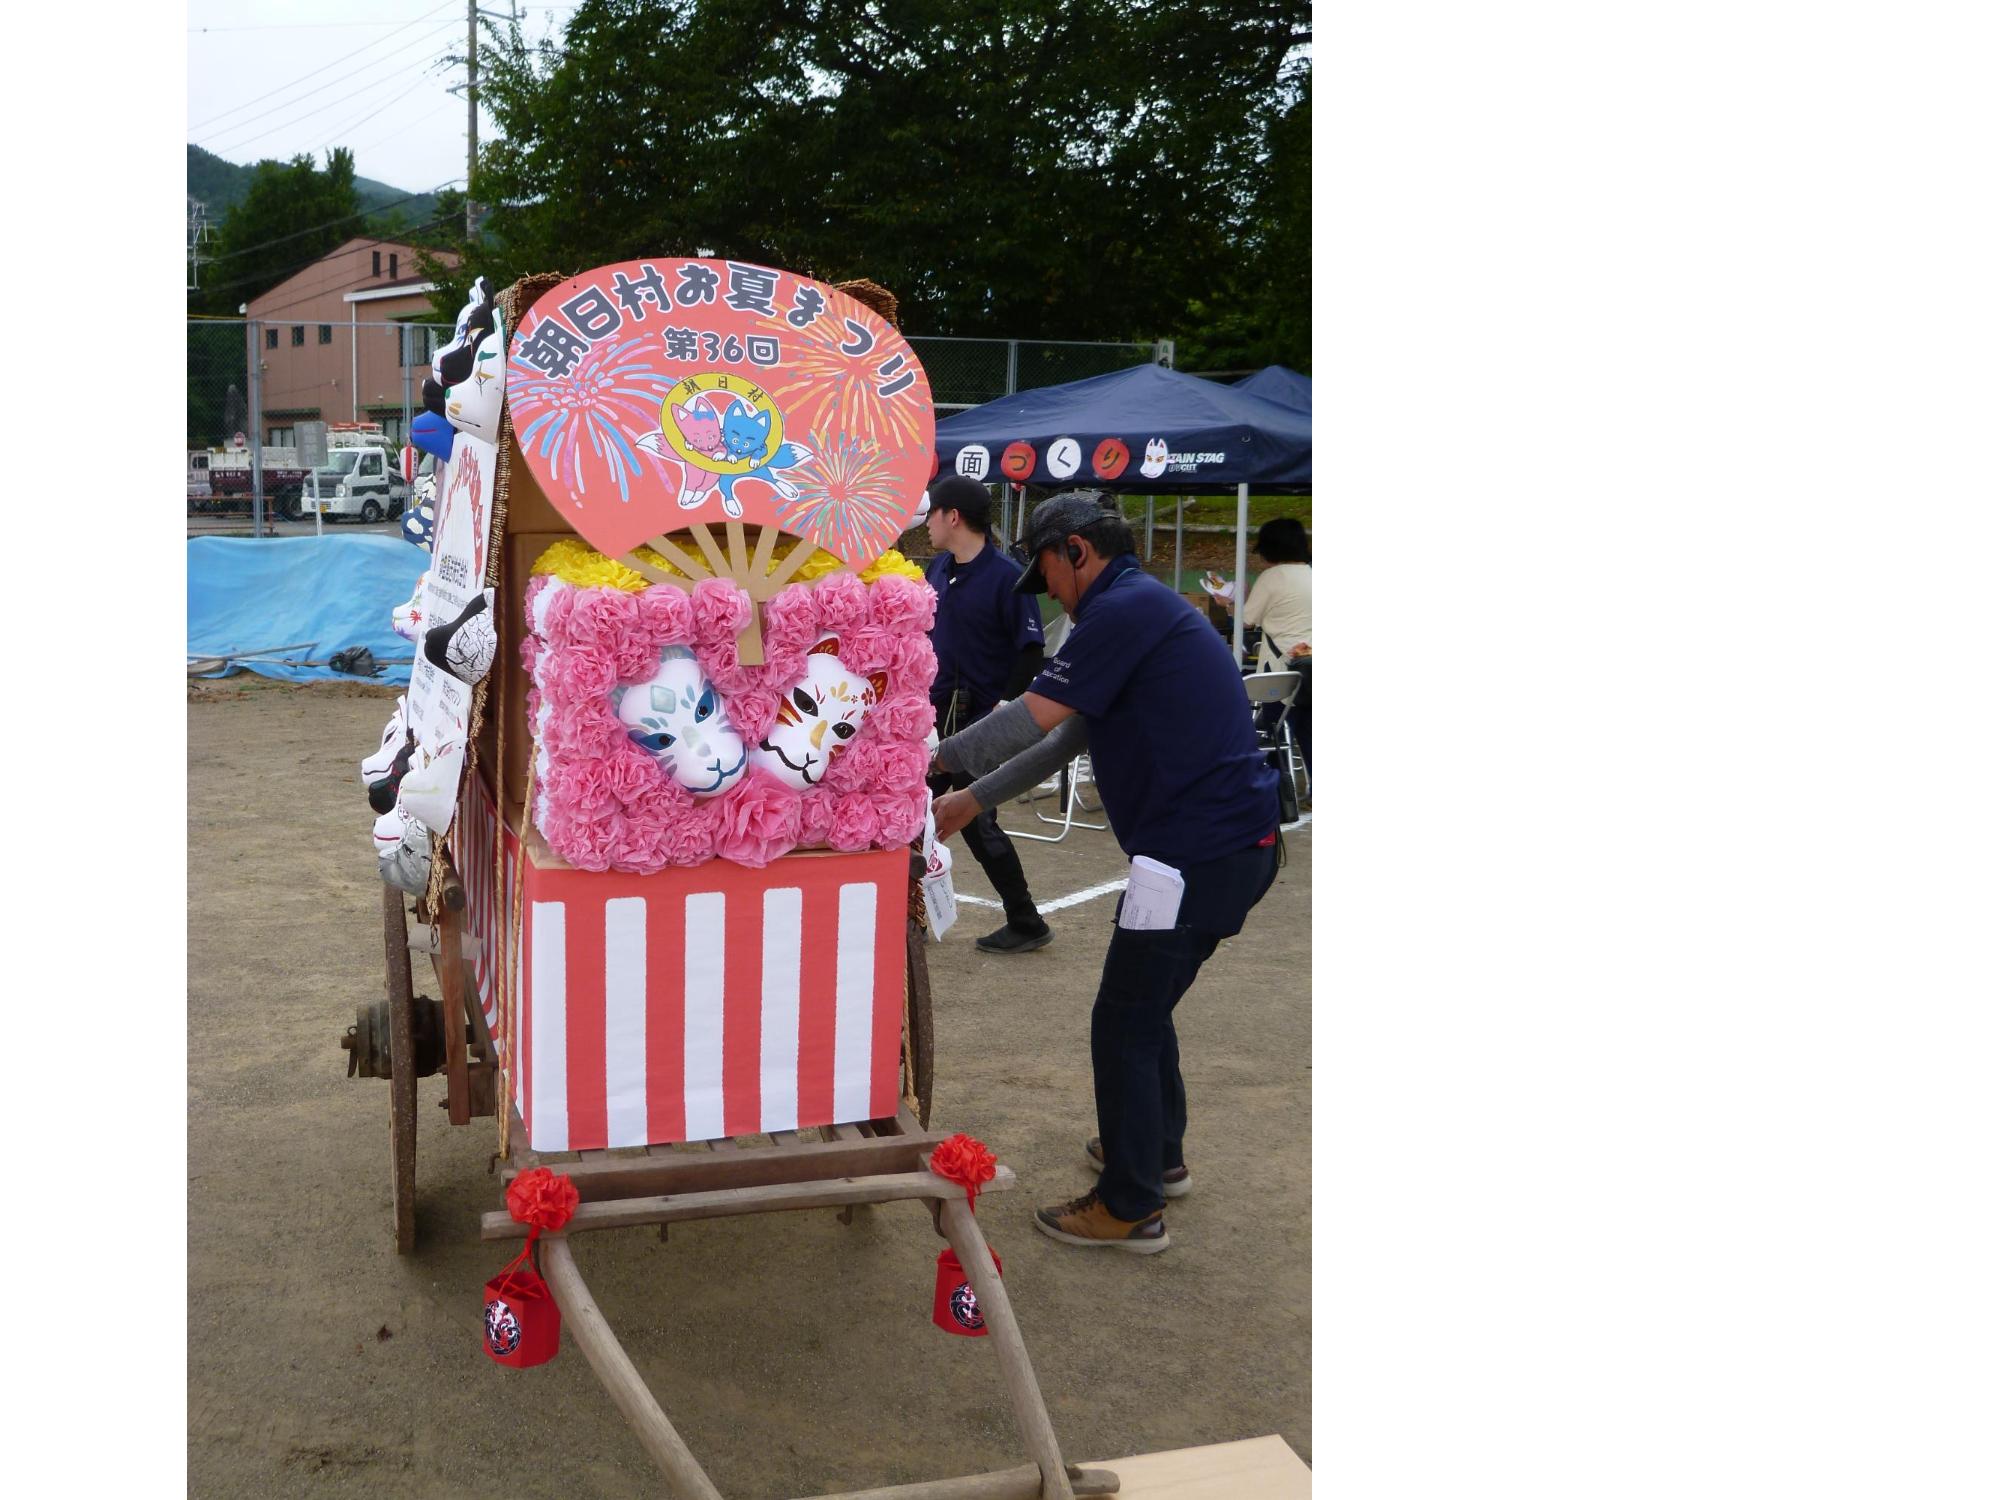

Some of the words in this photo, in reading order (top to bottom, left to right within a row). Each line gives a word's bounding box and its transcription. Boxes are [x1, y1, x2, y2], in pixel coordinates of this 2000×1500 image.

[516, 261, 916, 397] 朝日村お夏まつり
[661, 325, 780, 366] 第36回
[681, 376, 764, 403] 朝日村
[1168, 453, 1195, 464] TAIN
[1196, 453, 1225, 464] STAG
